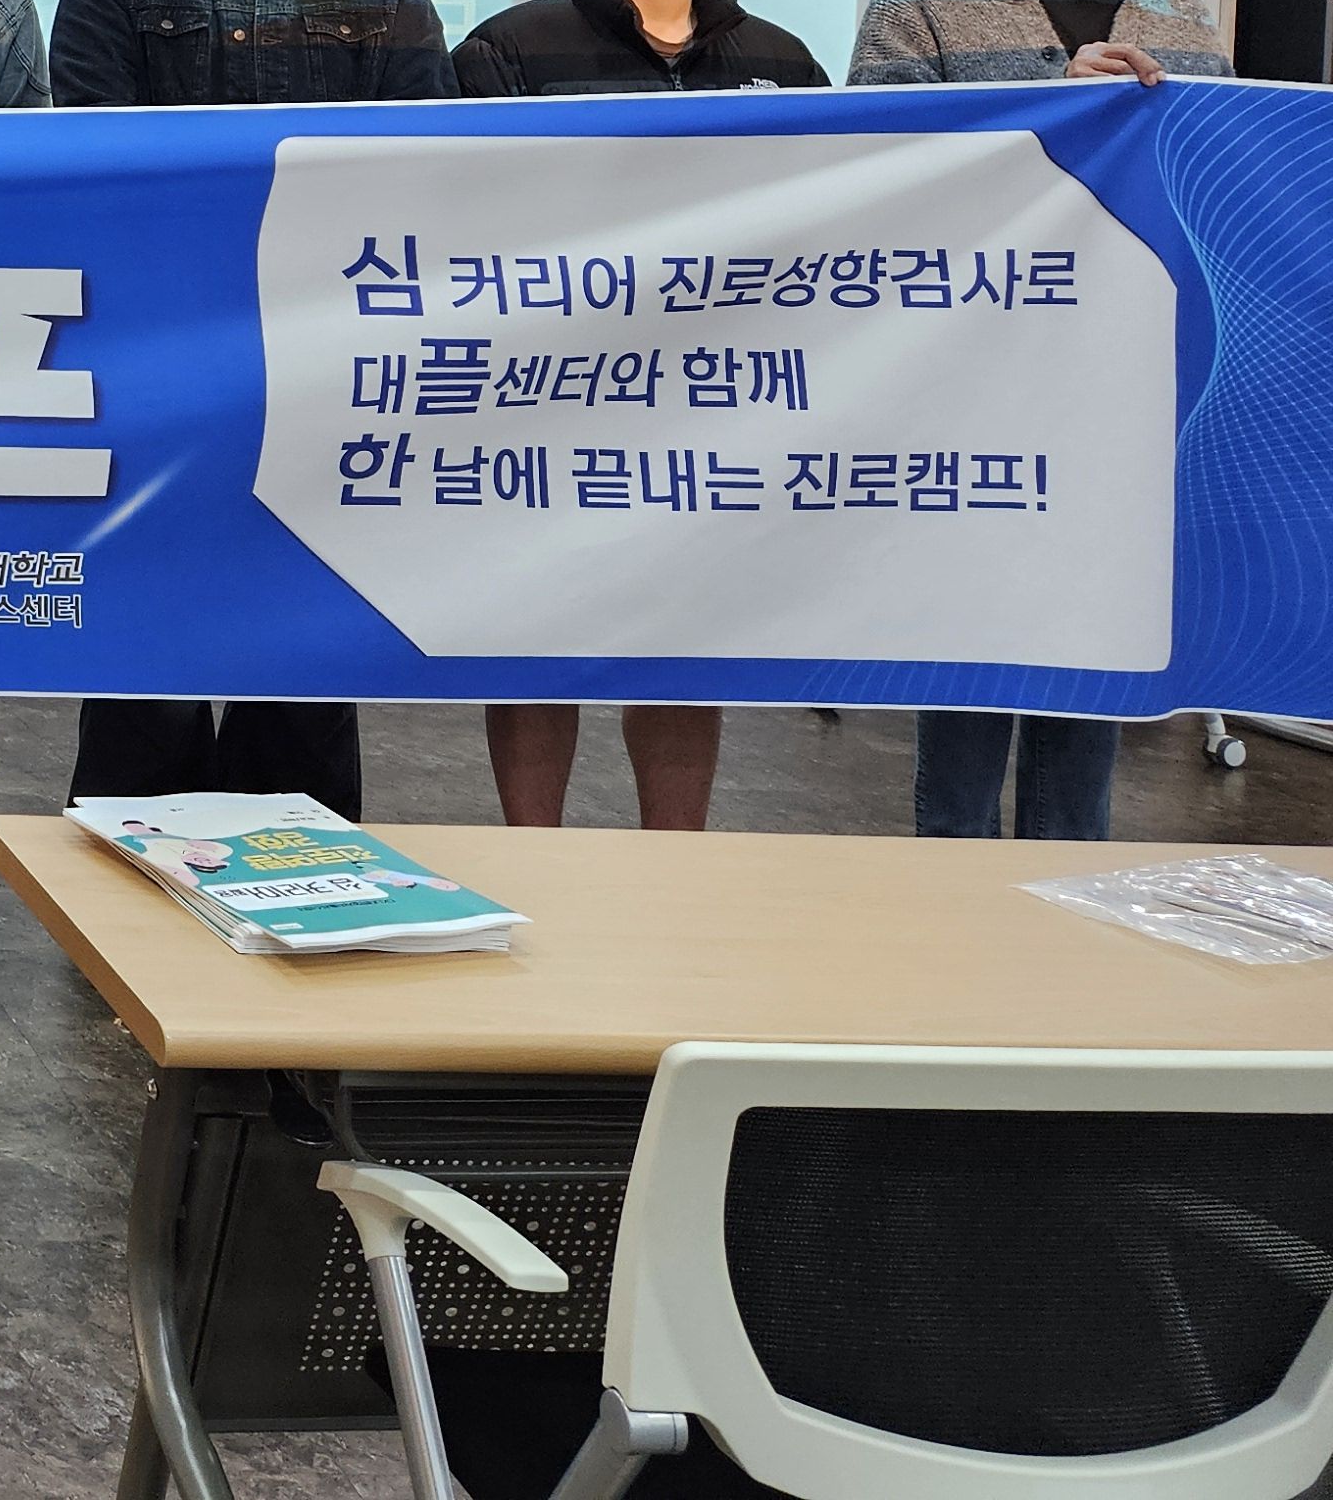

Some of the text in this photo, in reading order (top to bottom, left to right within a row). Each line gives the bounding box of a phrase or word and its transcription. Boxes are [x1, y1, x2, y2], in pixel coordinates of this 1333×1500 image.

[342, 235, 1078, 317] 심 커리어 진로성향검사로
[351, 337, 809, 416] 대플센터와 함께
[338, 432, 1048, 513] 한 날에 끝내는 진로캠프!
